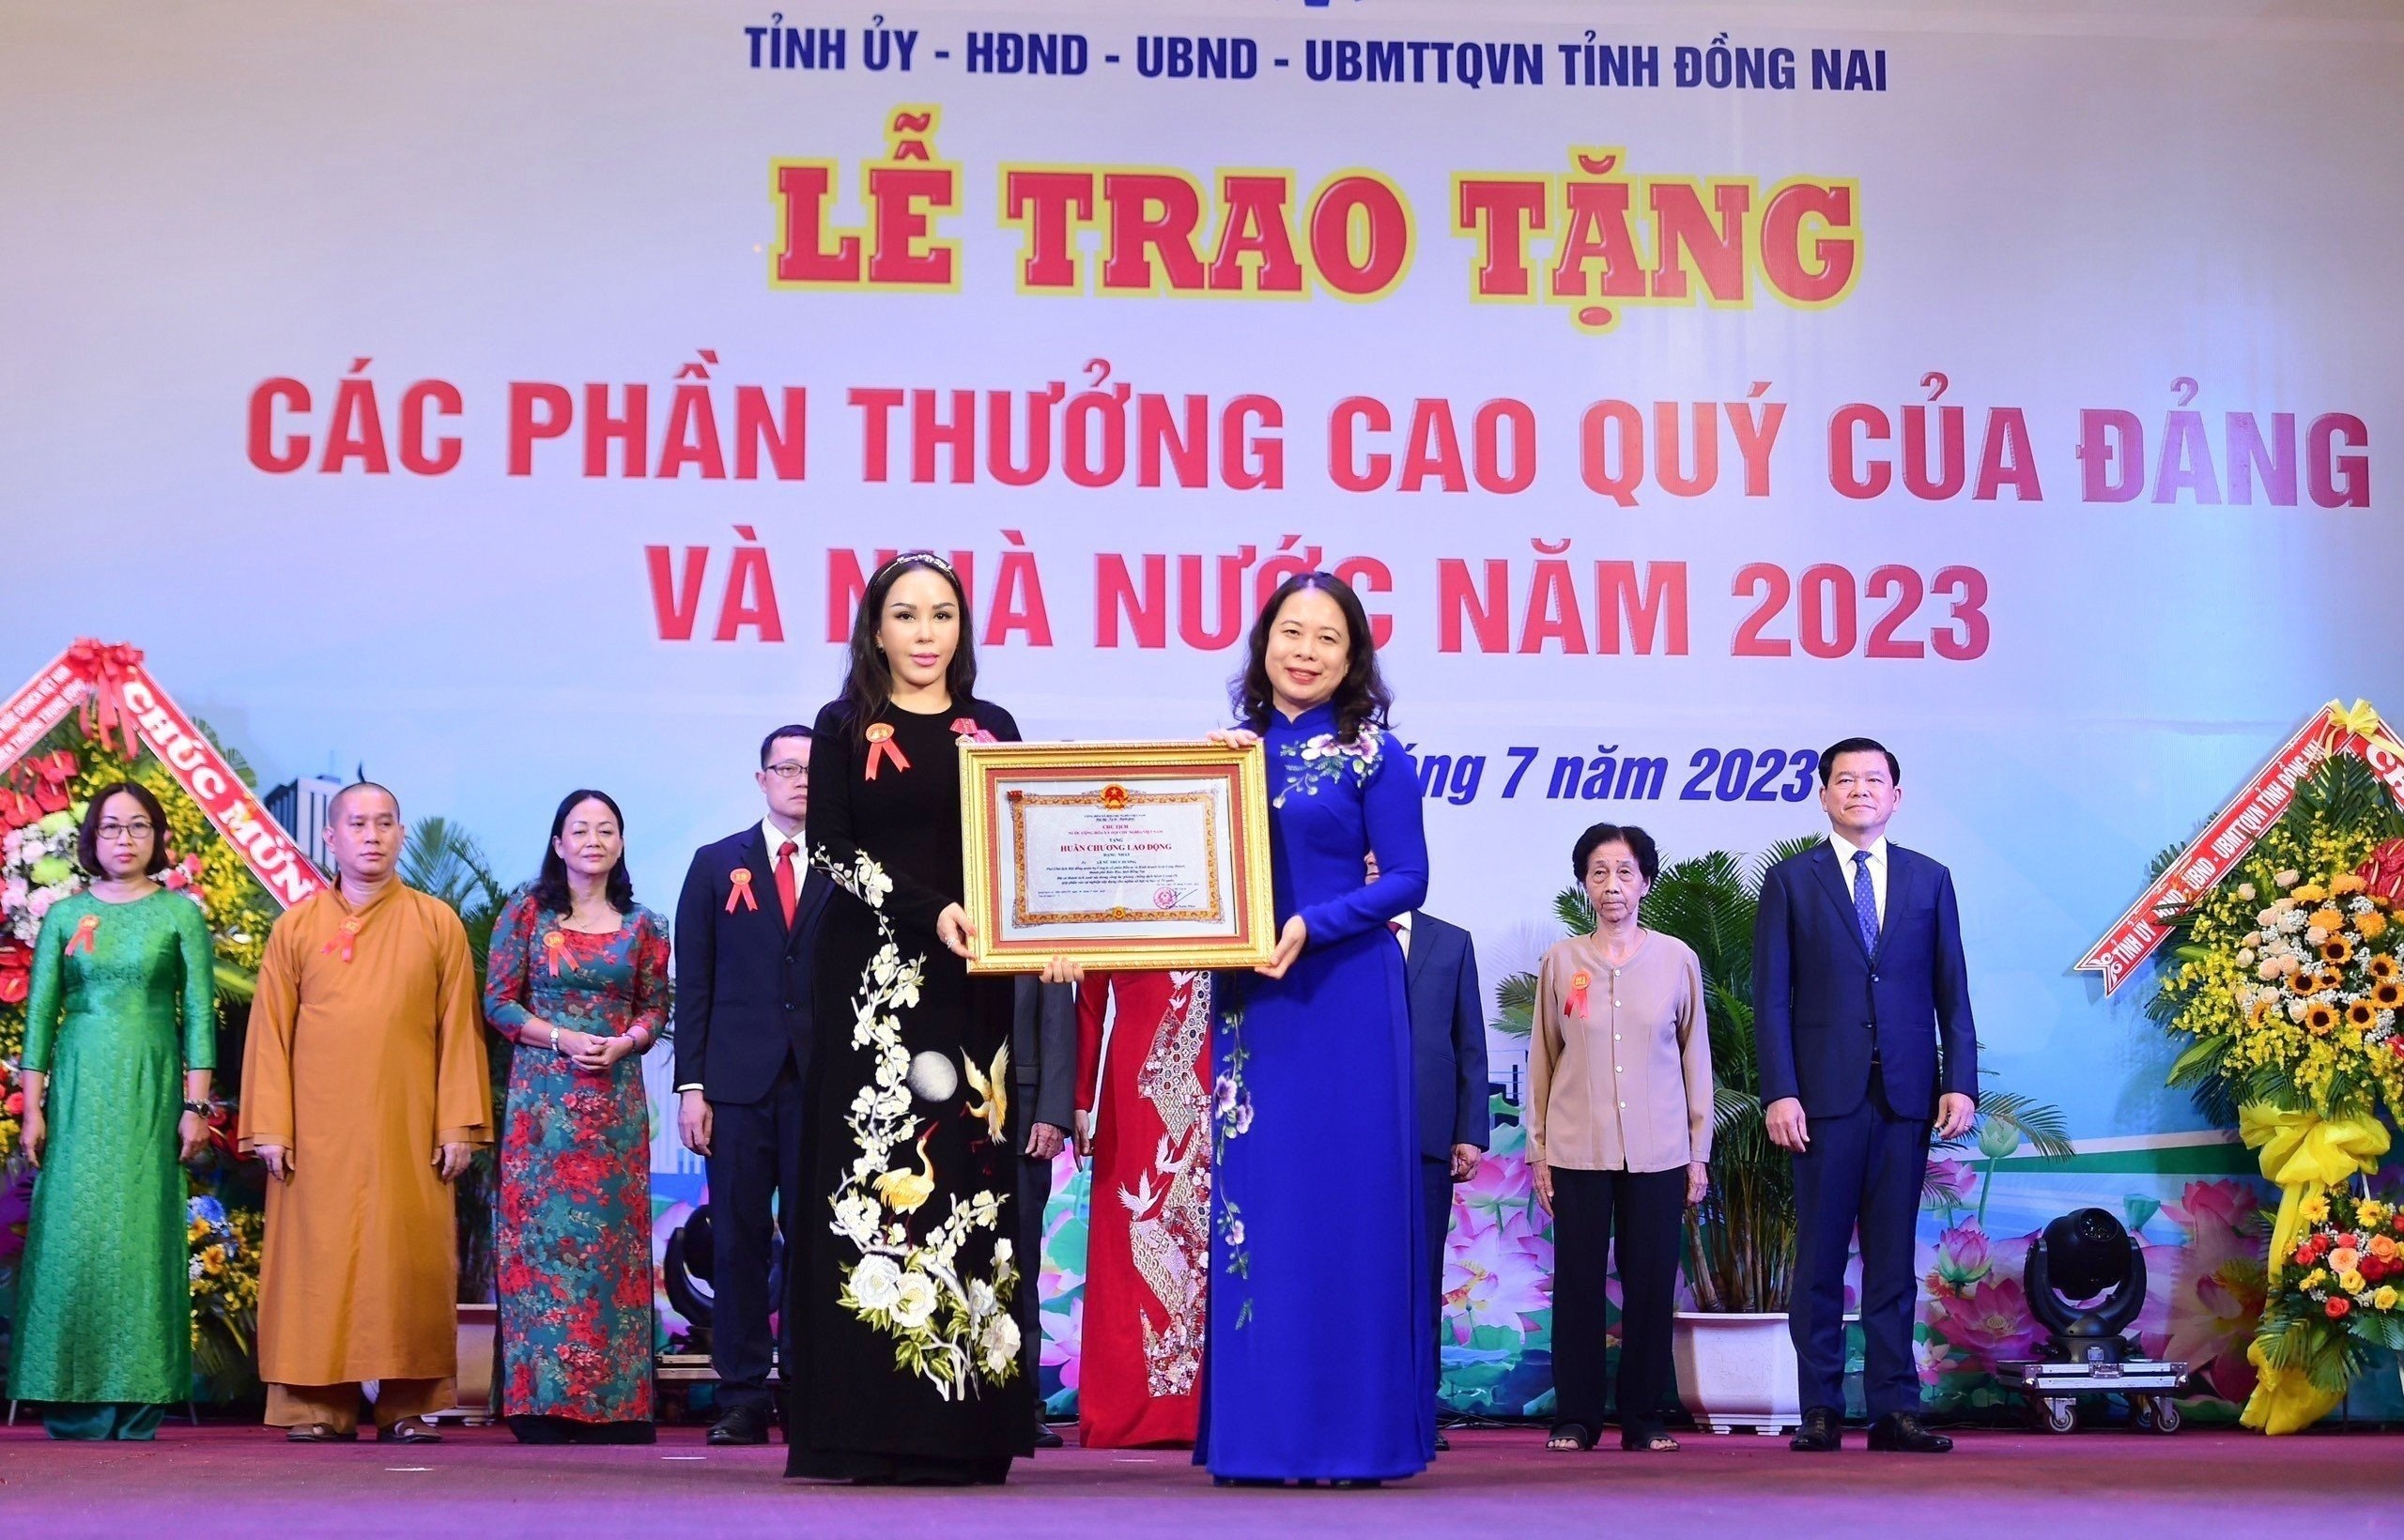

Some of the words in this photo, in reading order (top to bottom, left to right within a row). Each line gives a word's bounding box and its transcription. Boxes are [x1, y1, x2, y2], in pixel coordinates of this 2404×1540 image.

[745, 12, 845, 69] TỈNH
[863, 14, 919, 71] ỦY
[966, 31, 1089, 76] HĐND
[1136, 36, 1258, 80] UBND
[1304, 39, 1544, 89] UBMTTQVN
[1558, 29, 1659, 87] TỈNH
[1673, 31, 1796, 90] ĐỒNG
[1811, 48, 1888, 92] NAI
[774, 109, 956, 288] LỄ
[1003, 169, 1410, 298] TRAO
[1456, 152, 1858, 329] TẶNG
[246, 357, 464, 476] CÁC
[506, 348, 808, 482] PHẦN
[847, 358, 1284, 490] THƯỞNG
[1327, 394, 1537, 495] CAO
[1579, 381, 1788, 508] QUÝ
[1826, 371, 2044, 501] CỦA
[2075, 376, 2371, 509] ĐẢNG
[643, 524, 785, 643] VÀ
[825, 529, 1054, 648] NÀ
[1435, 537, 1690, 656] NĂM
[1730, 562, 1991, 661] 2023
[122, 680, 226, 800] CHÚC
[217, 799, 320, 903] MỪN
[1502, 747, 1539, 799] 7
[1547, 744, 1669, 801] năm
[1680, 747, 1819, 803] 2023
[2254, 786, 2289, 812] TỈNH
[1060, 843, 1086, 853] HUÂN
[1086, 843, 1125, 853] CHƯƠNG
[2210, 802, 2269, 859] UBMTTQVN
[2181, 856, 2216, 890] UBND
[2110, 939, 2145, 965] TỈNH
[2127, 920, 2157, 943] ỦY
